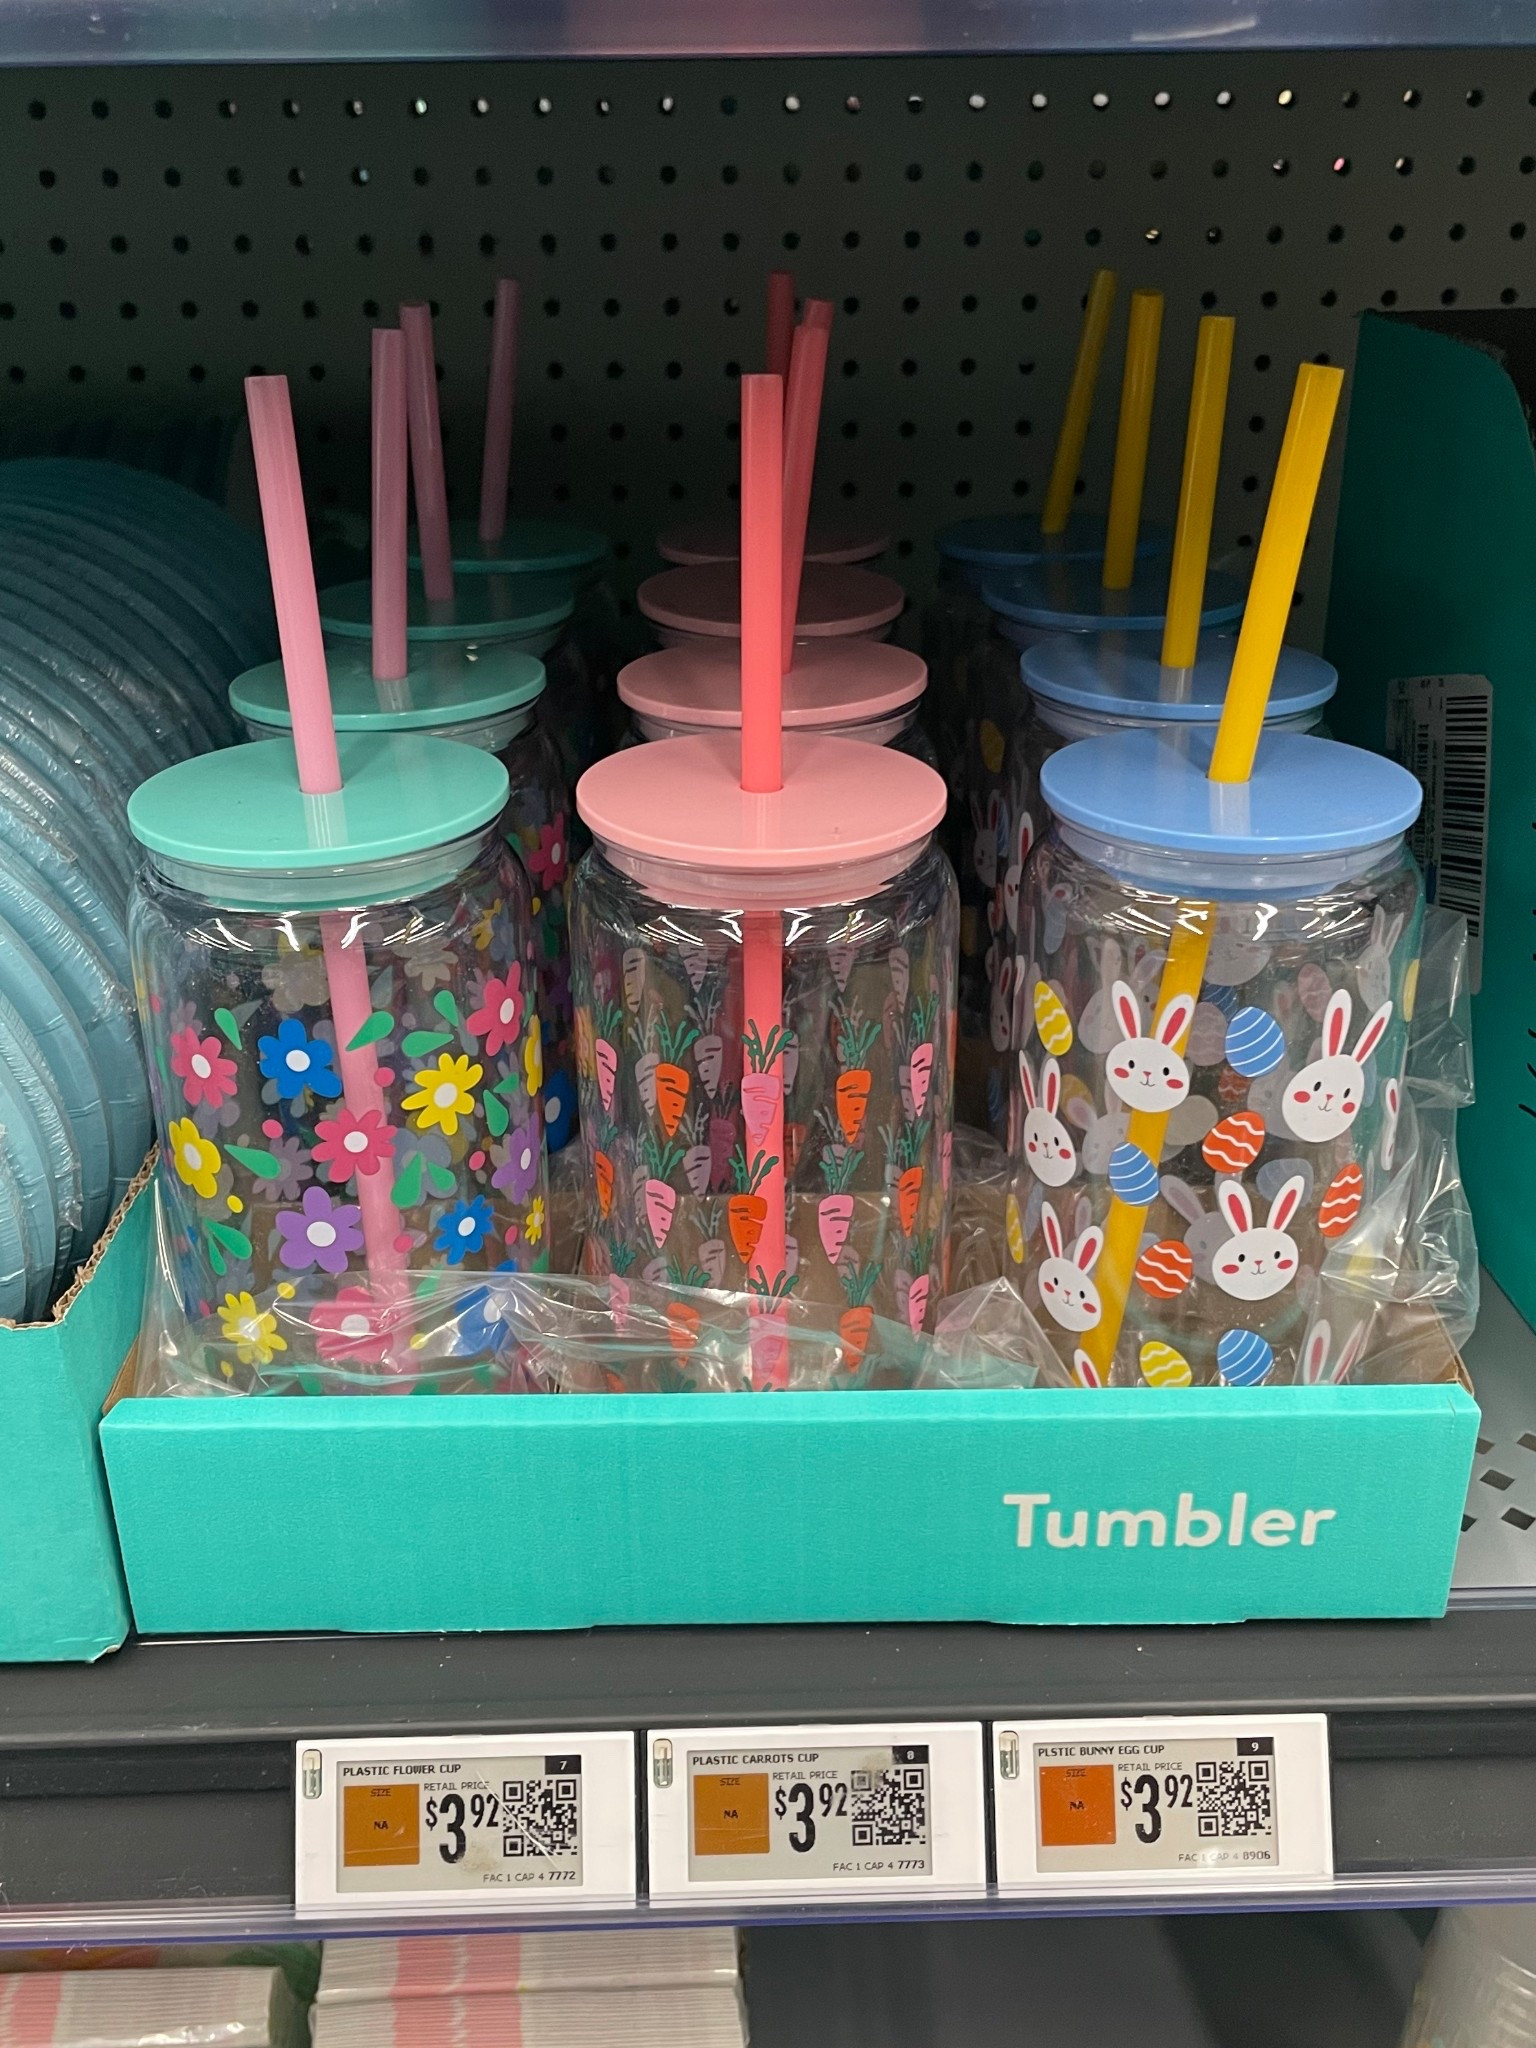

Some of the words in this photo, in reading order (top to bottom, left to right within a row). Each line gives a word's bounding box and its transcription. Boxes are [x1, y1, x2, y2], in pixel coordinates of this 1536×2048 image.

[1003, 1492, 1337, 1548] Tumbler
[1038, 1747, 1076, 1757] PLSTIC
[1080, 1746, 1114, 1756] BUNNY
[1118, 1745, 1140, 1755] EGG
[1144, 1744, 1165, 1754] CUP
[1251, 1742, 1259, 1752] 9
[693, 1755, 739, 1766] PLASTIC
[742, 1754, 794, 1764] CARROTS
[797, 1753, 819, 1763] CUP
[343, 1766, 389, 1777] PLASTIC
[393, 1765, 435, 1776] FLOWER
[440, 1764, 461, 1774] CUP
[559, 1761, 567, 1770] 7
[1118, 1763, 1151, 1772] RETAIL
[1155, 1762, 1182, 1771] PRICE
[772, 1771, 805, 1780] RETAIL
[809, 1770, 838, 1779] PRICE
[1065, 1768, 1086, 1778] SIZE
[424, 1782, 457, 1791] RETAIL
[461, 1781, 490, 1790] PRICE
[720, 1777, 741, 1786] SIZE
[370, 1788, 391, 1797] SIZE
[1069, 1801, 1085, 1811] NA
[724, 1810, 739, 1820] NA
[374, 1820, 389, 1830] NA
[1178, 1853, 1198, 1861] FAC
[833, 1862, 852, 1871] FAC
[864, 1861, 884, 1870] CAP
[887, 1861, 893, 1870] 4
[897, 1860, 925, 1870] 7773
[483, 1873, 502, 1882] FAC
[516, 1872, 535, 1881] CAP
[538, 1872, 545, 1881] 4
[548, 1871, 576, 1881] 7772
